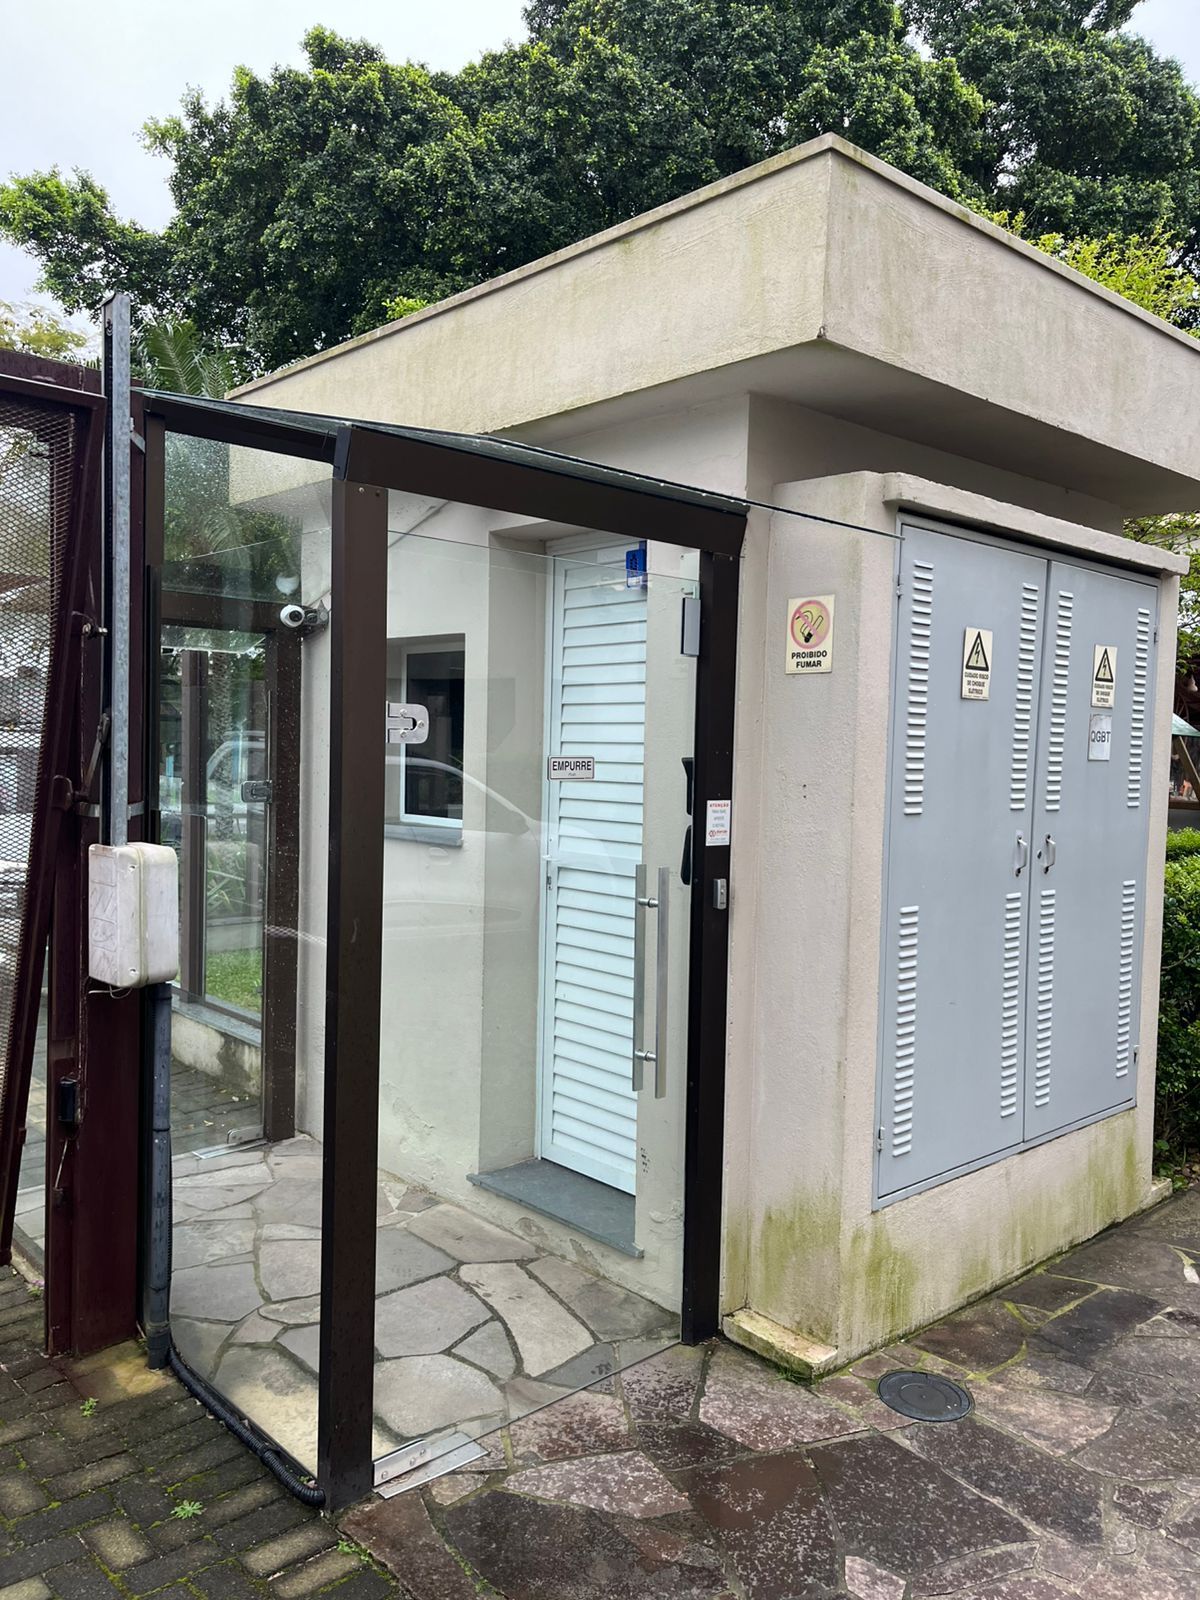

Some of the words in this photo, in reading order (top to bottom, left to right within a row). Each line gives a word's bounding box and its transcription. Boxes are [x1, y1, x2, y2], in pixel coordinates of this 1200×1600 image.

[791, 650, 828, 660] PROIBIDO
[796, 660, 822, 669] FUMAR
[1090, 730, 1111, 743] QGBT
[552, 760, 592, 771] EMPURRE
